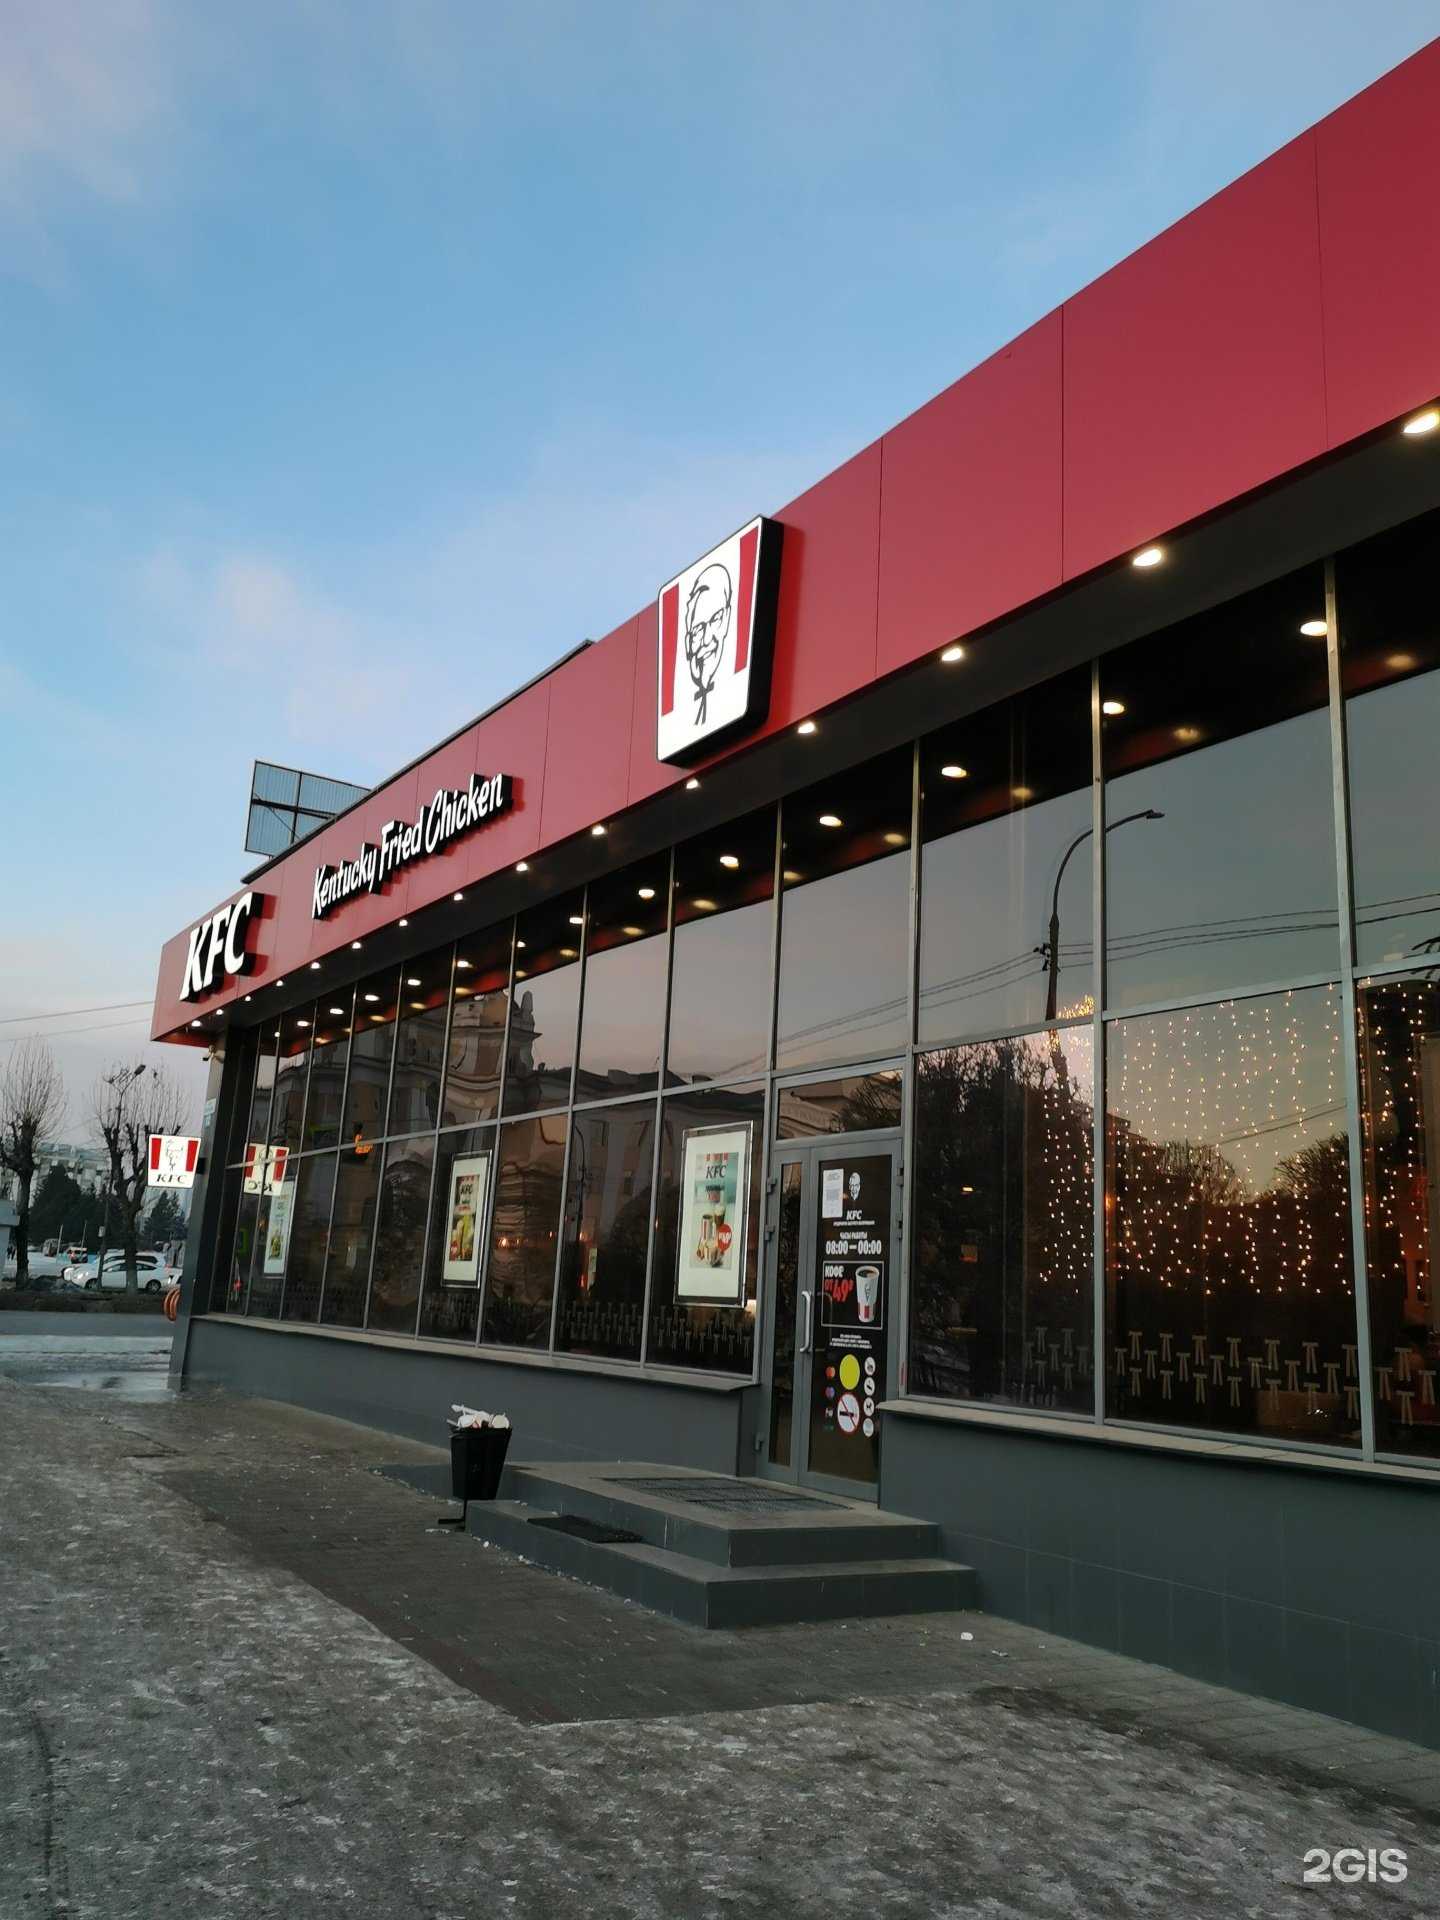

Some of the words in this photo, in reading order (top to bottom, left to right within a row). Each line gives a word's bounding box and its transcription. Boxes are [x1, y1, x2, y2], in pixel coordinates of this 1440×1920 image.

[312, 843, 377, 918] Kentucky
[379, 806, 423, 881] Fried
[425, 774, 503, 853] Chicken
[180, 892, 252, 1000] KFC
[156, 1174, 186, 1184] KFC
[706, 1165, 727, 1179] KFC
[846, 1210, 863, 1220] KFC
[825, 1240, 848, 1255] 08:00
[858, 1239, 882, 1255] 00:00
[825, 1265, 845, 1278] КОФЕ
